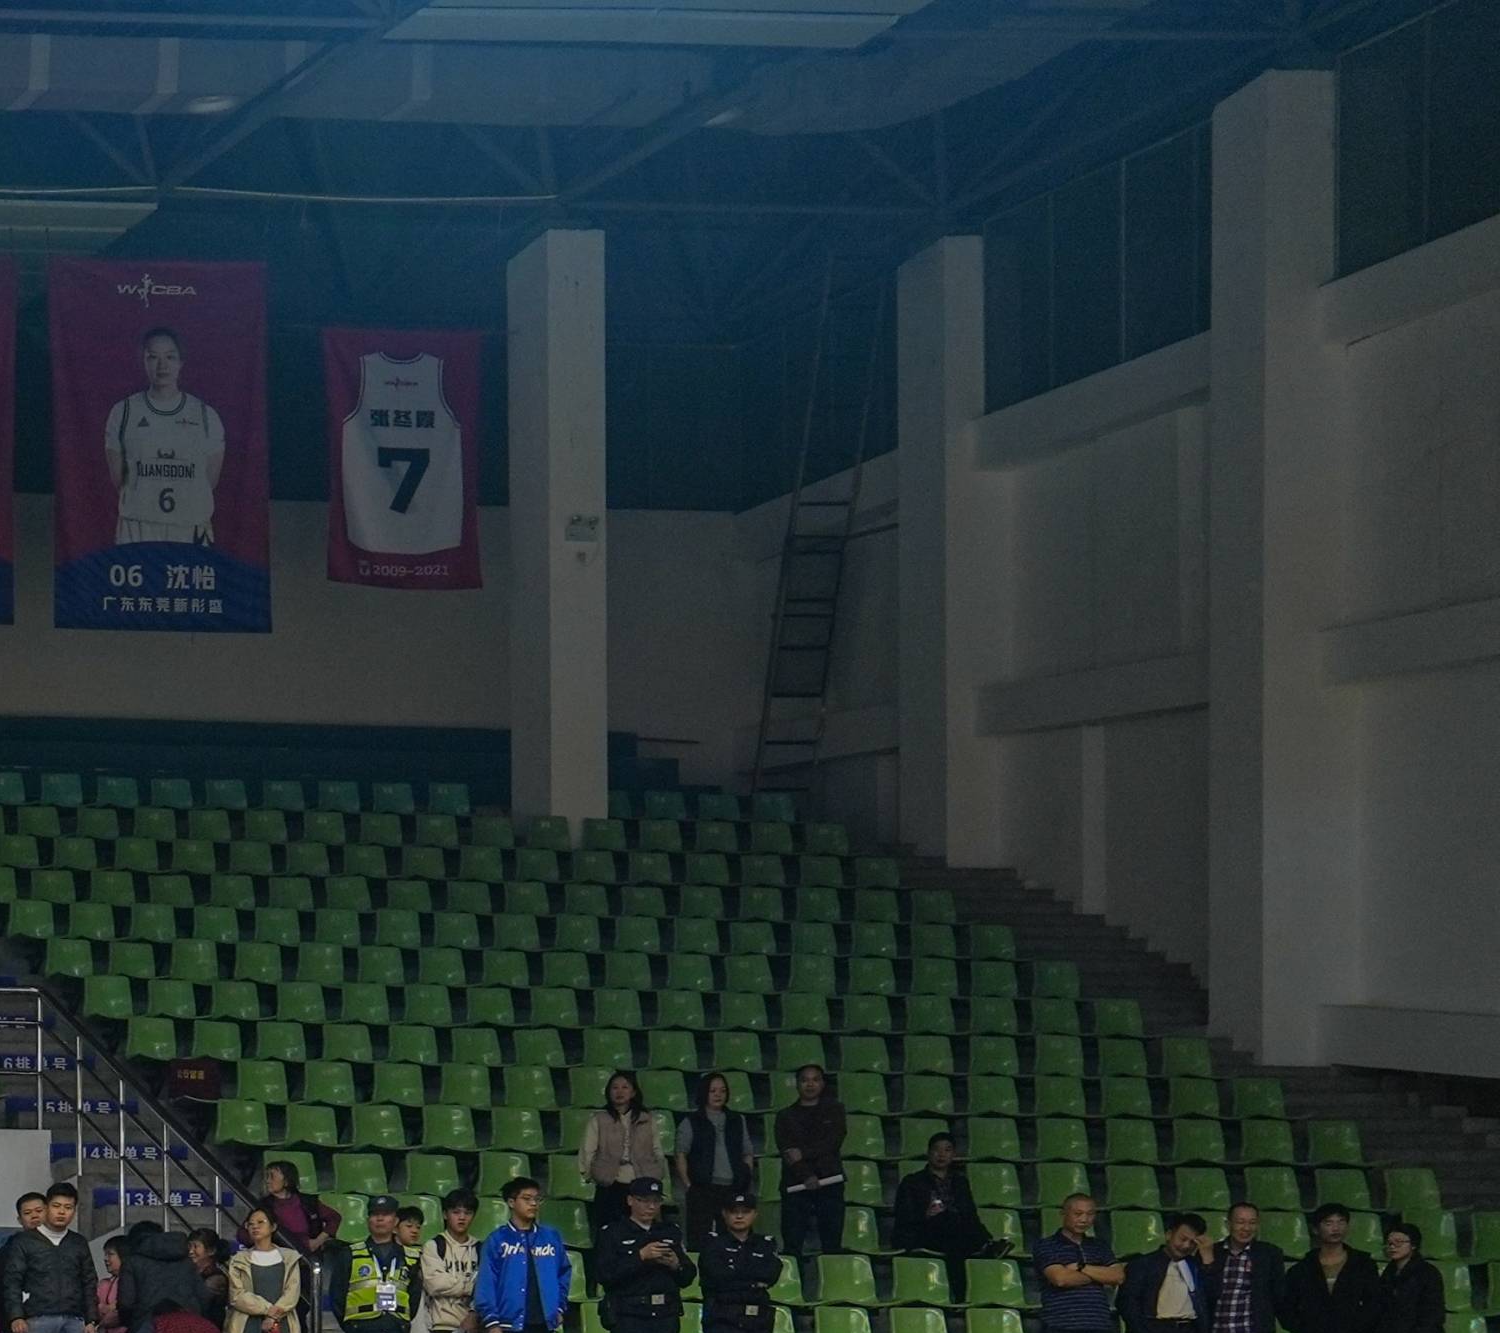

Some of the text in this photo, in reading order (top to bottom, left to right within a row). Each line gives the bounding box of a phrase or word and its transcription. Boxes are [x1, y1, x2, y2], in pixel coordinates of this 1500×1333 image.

[376, 447, 431, 514] 7
[158, 487, 176, 514] 6
[109, 564, 143, 589] 06
